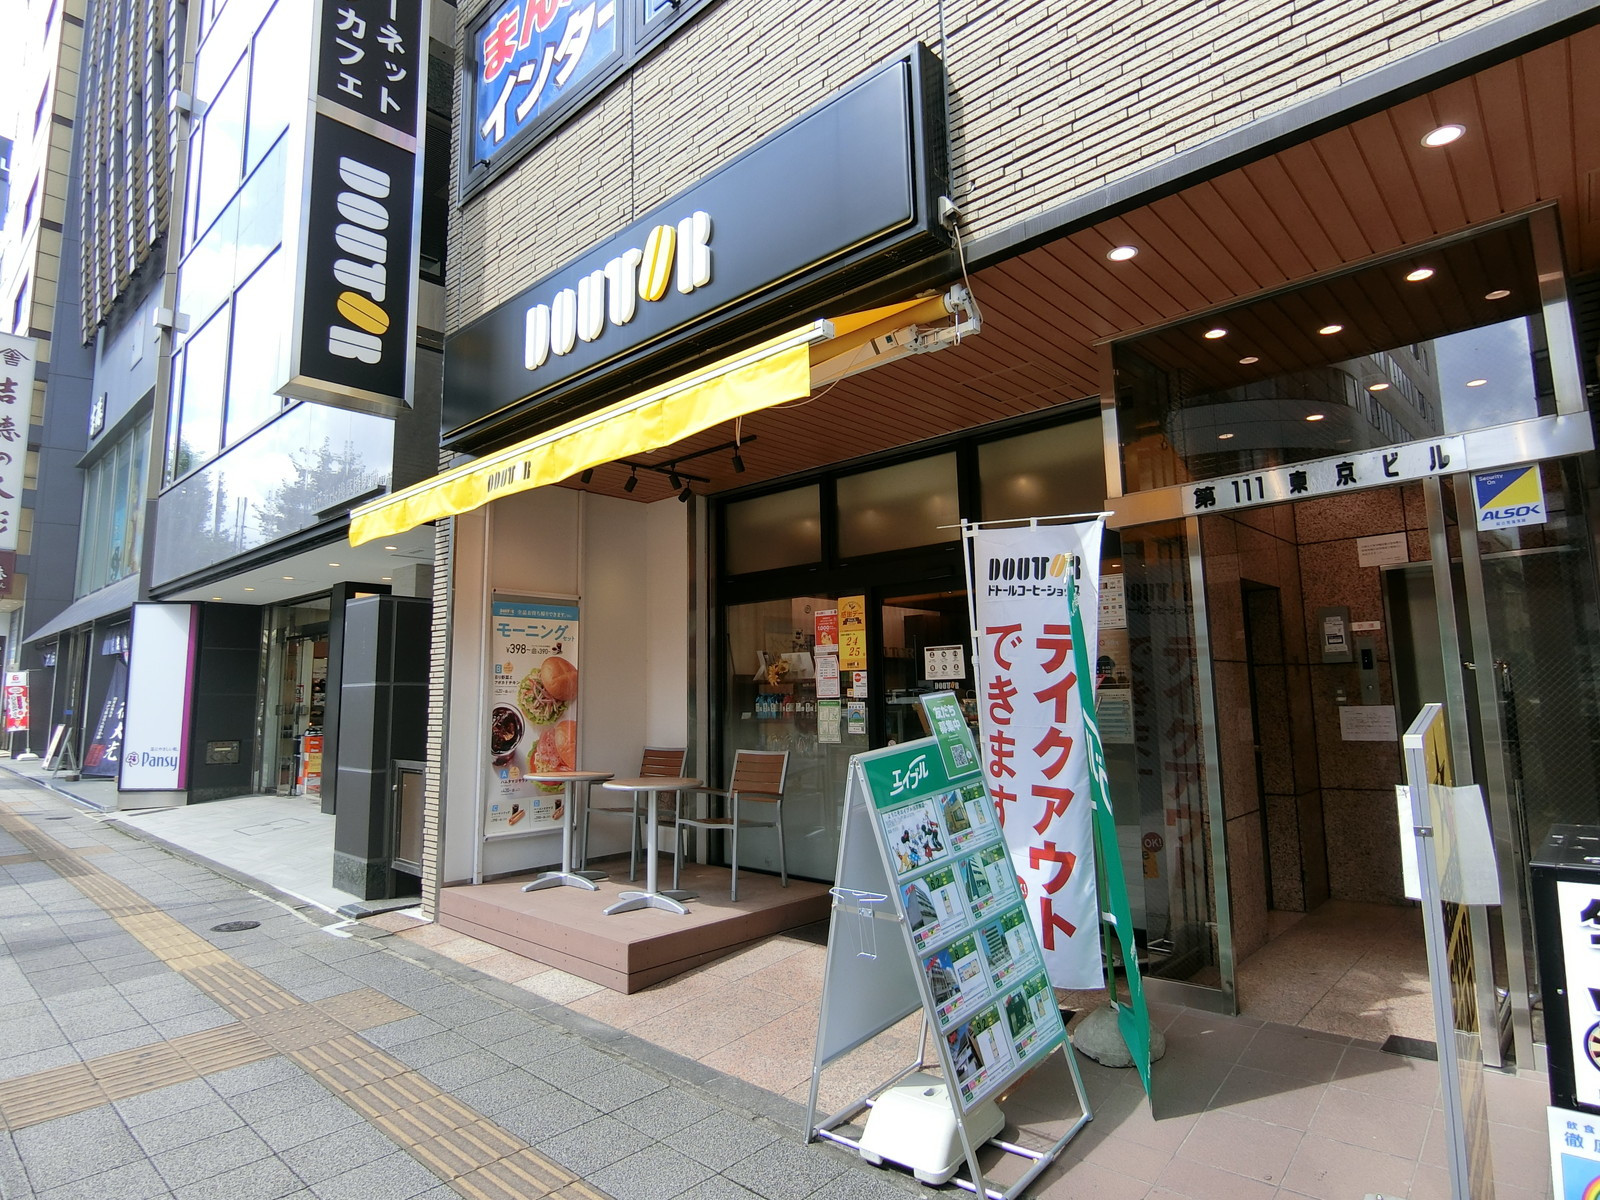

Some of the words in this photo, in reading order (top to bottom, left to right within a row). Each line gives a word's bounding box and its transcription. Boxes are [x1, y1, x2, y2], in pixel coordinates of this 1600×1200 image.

[336, 7, 367, 99] カフェ
[484, 0, 570, 83] まん
[328, 156, 391, 365] DOUTOR
[525, 210, 711, 371] DOUTOR
[488, 460, 531, 492] DOUTOR
[1193, 444, 1450, 510] 第111東京ビル
[1478, 474, 1504, 482] Security
[1481, 504, 1541, 521] ALSOK
[988, 553, 1081, 580] DOUTOR
[496, 622, 569, 641] モーニング
[934, 681, 960, 690] DOUTOR
[932, 704, 956, 719] 友だち
[141, 752, 178, 771] Pansy
[890, 754, 929, 796] エイブル
[1029, 624, 1078, 951] テイクアウト
